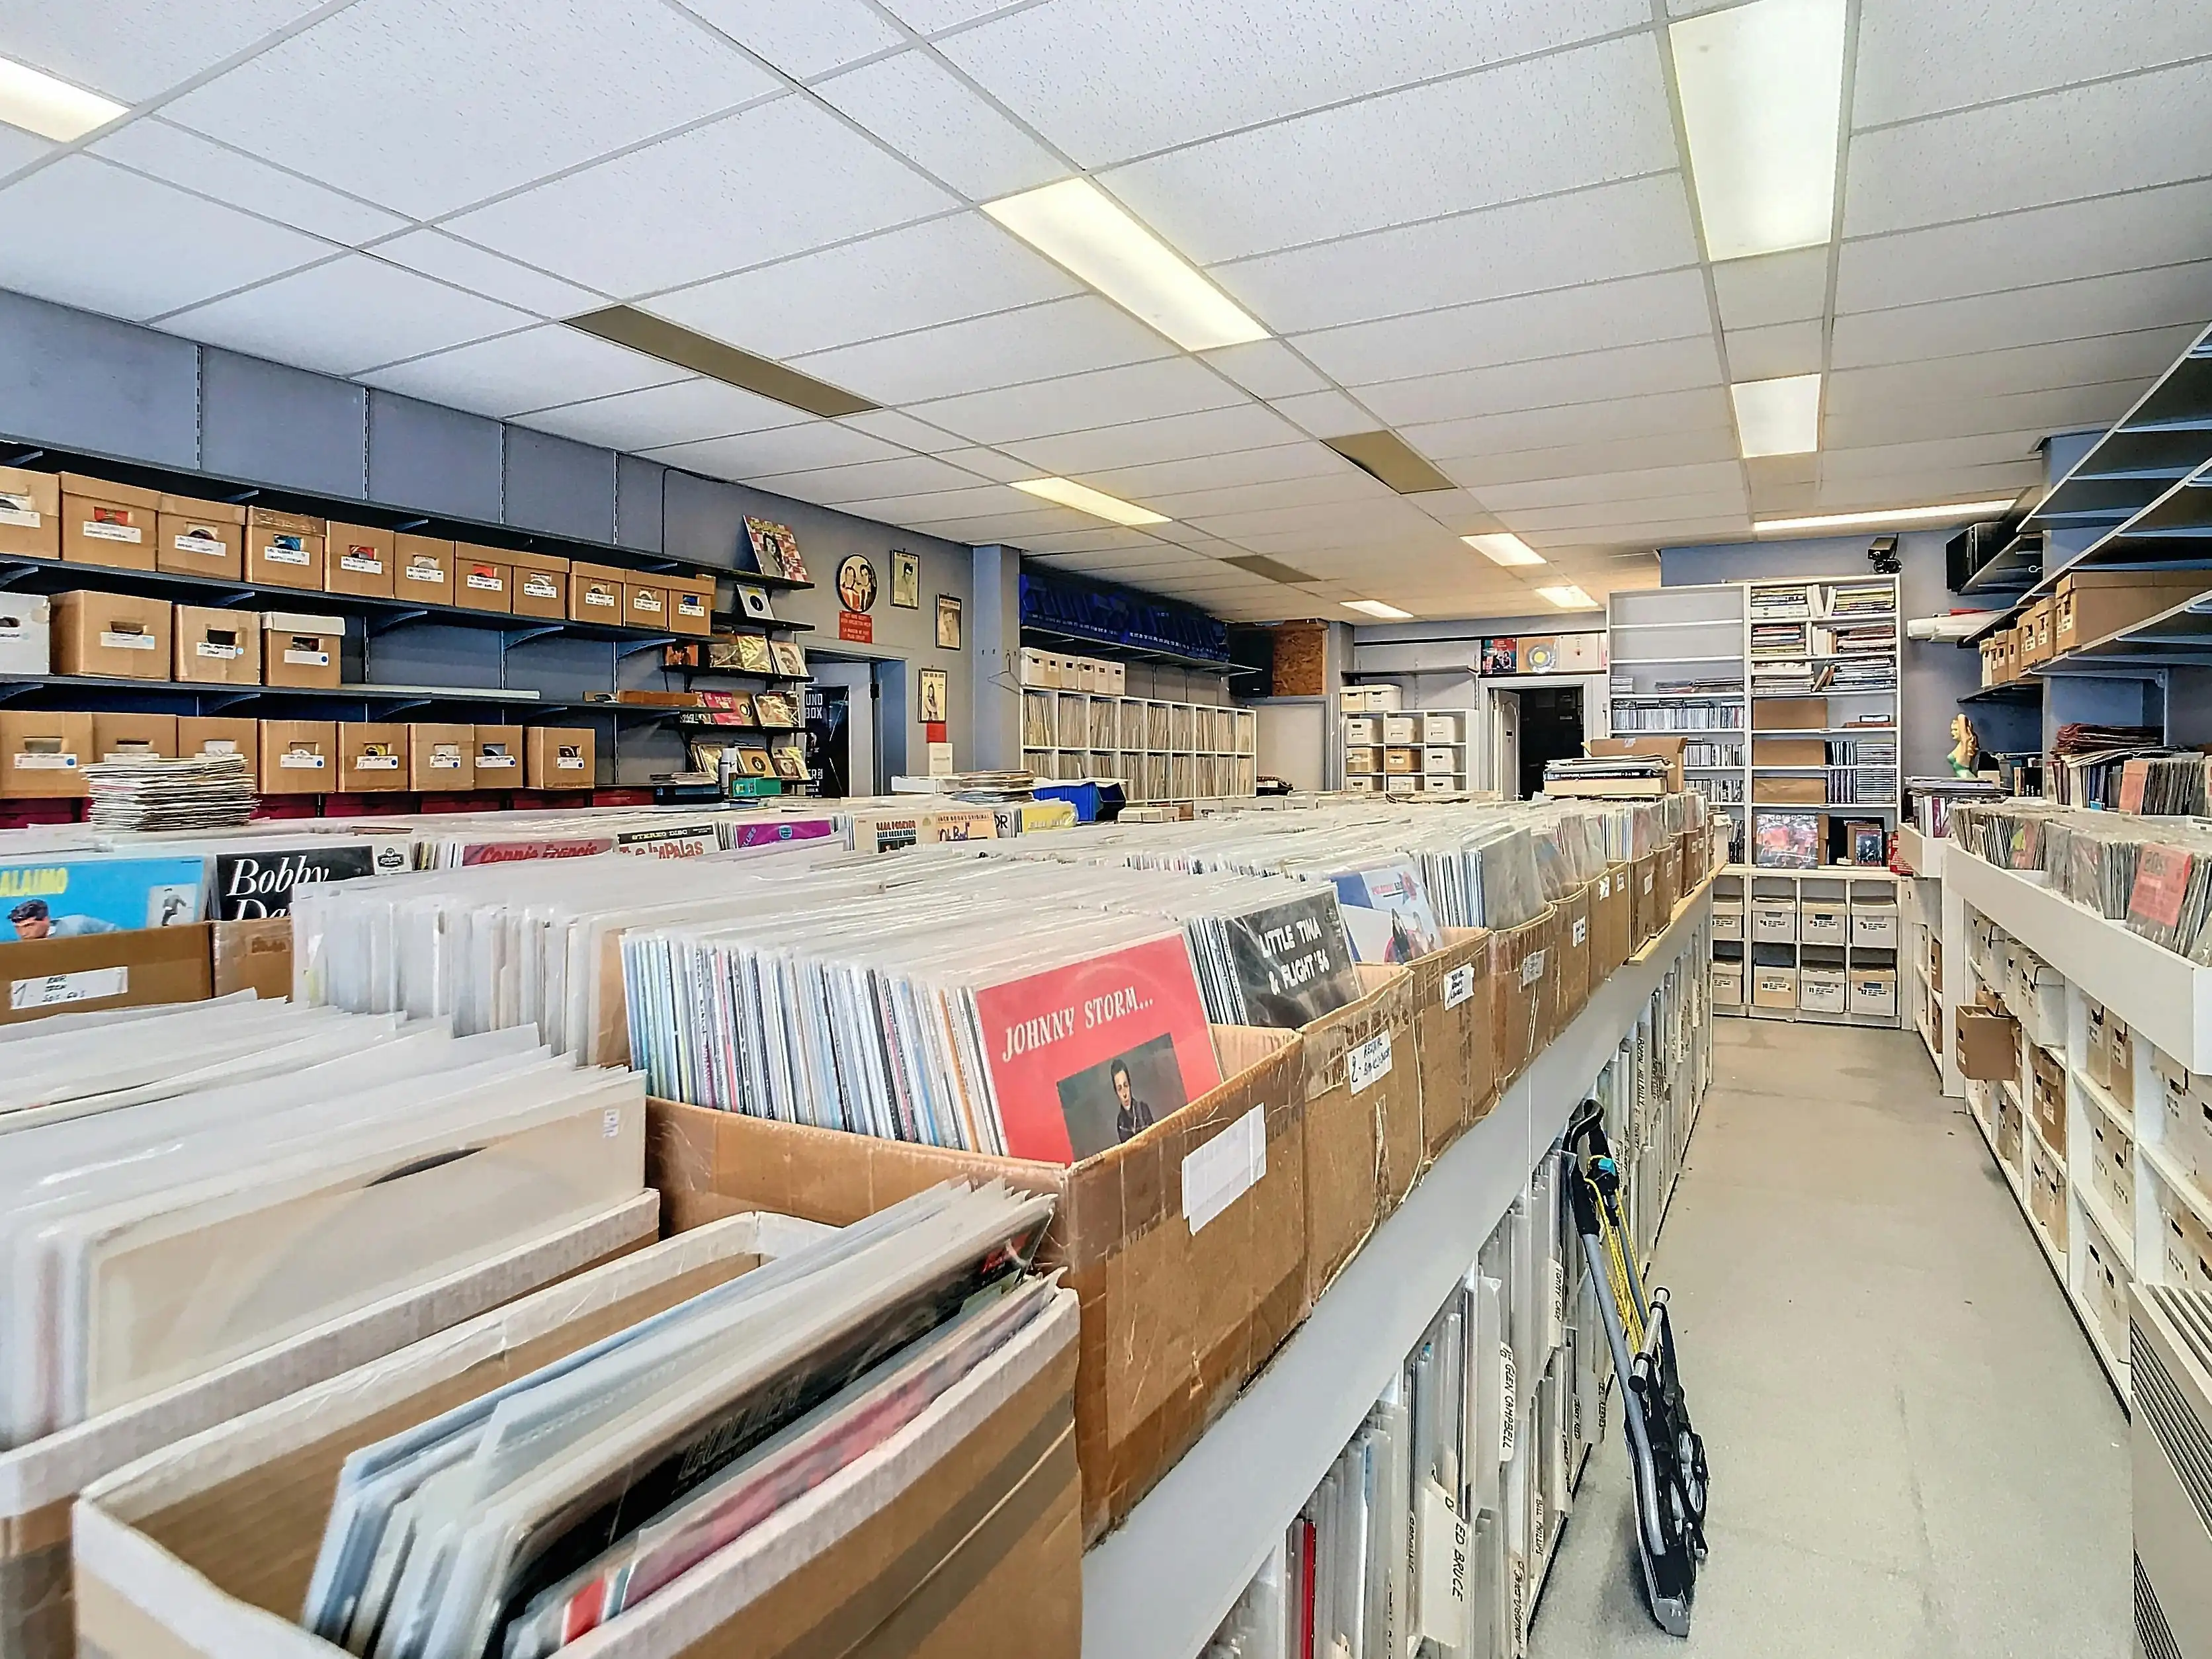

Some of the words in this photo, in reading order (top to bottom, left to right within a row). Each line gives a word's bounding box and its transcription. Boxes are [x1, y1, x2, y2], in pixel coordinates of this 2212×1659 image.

[631, 831, 667, 840] STEREO
[1258, 924, 1296, 958] LITTLE
[1296, 917, 1322, 944] TINA
[1268, 970, 1281, 996] &
[1001, 1006, 1075, 1064] JOHNNY
[1084, 985, 1154, 1029] STORM...
[1504, 1363, 1516, 1393] GLEN
[1502, 1395, 1514, 1449] CAMPBELL
[1455, 1522, 1466, 1545] ED
[1451, 1549, 1465, 1603] BRUCE
